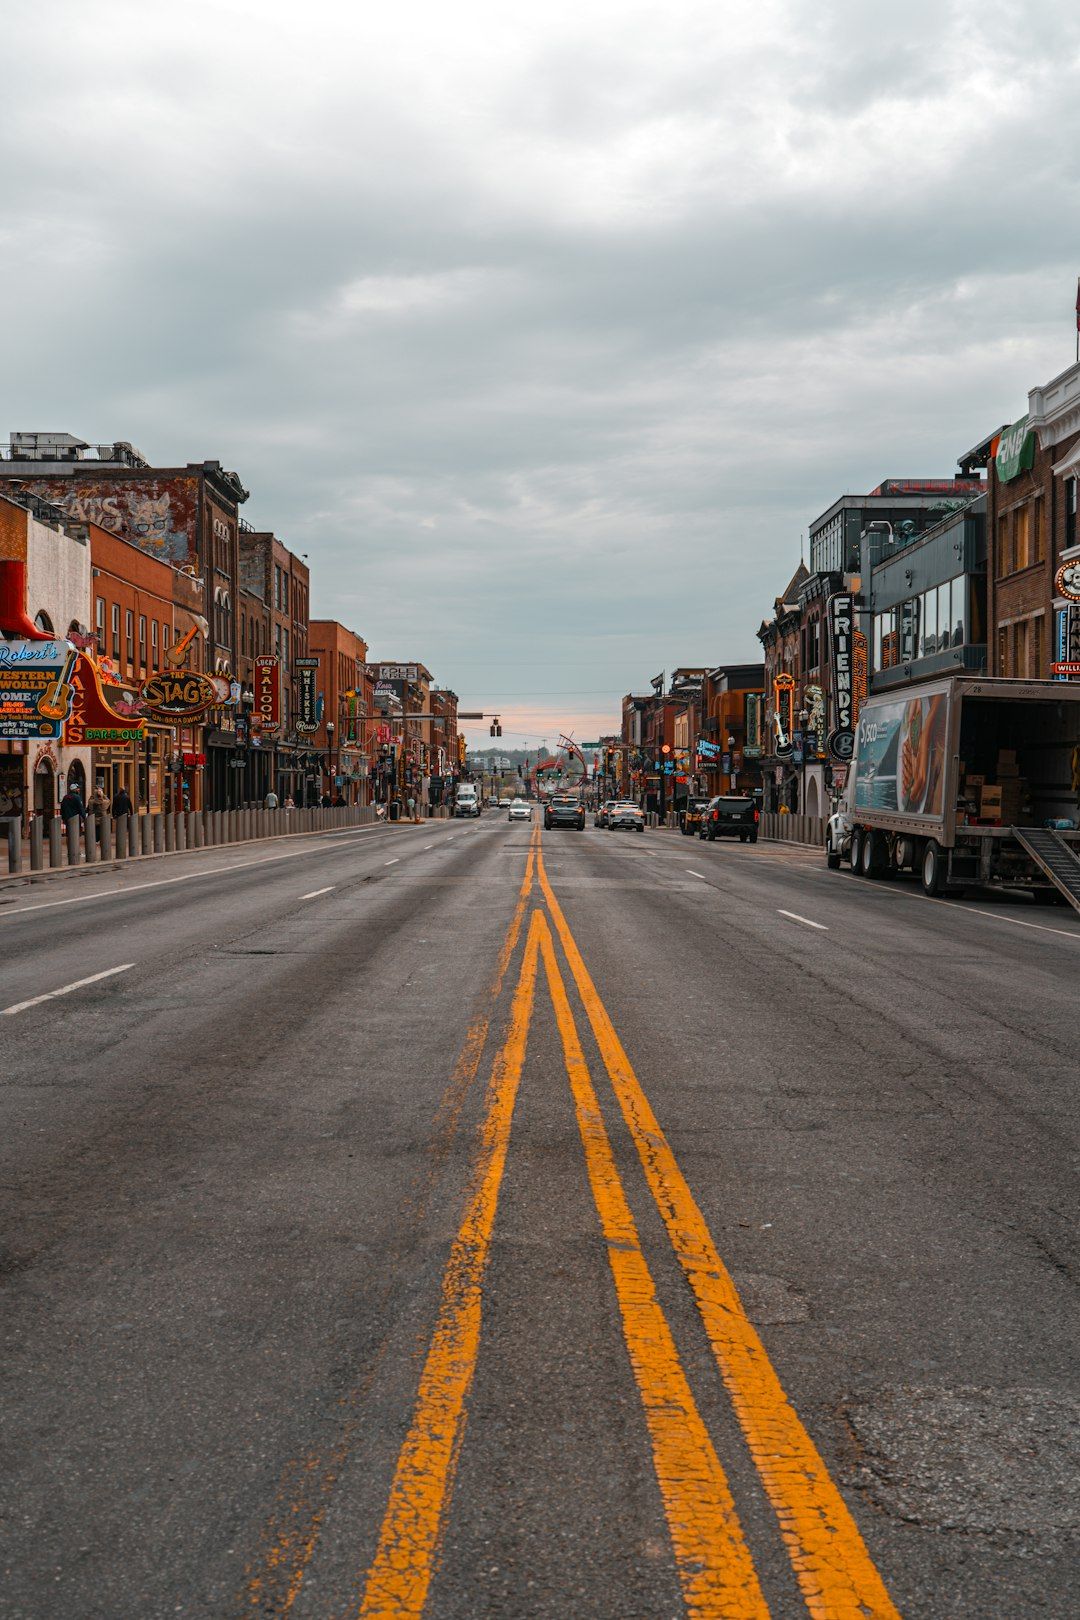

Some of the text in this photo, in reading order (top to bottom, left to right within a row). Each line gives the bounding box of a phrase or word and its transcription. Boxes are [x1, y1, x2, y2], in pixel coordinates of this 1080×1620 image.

[0, 643, 57, 669] Robert's
[256, 659, 278, 667] LUCKY
[834, 597, 851, 728] FRIENDS
[170, 671, 186, 679] THE
[0, 693, 31, 701] OME
[68, 658, 87, 743] JACKS
[143, 677, 213, 706] STAGE
[260, 667, 273, 722] SALOON
[303, 670, 311, 722] WHISKEY
[164, 714, 203, 724] BROADWAY
[86, 729, 143, 740] BAR-B-QUE
